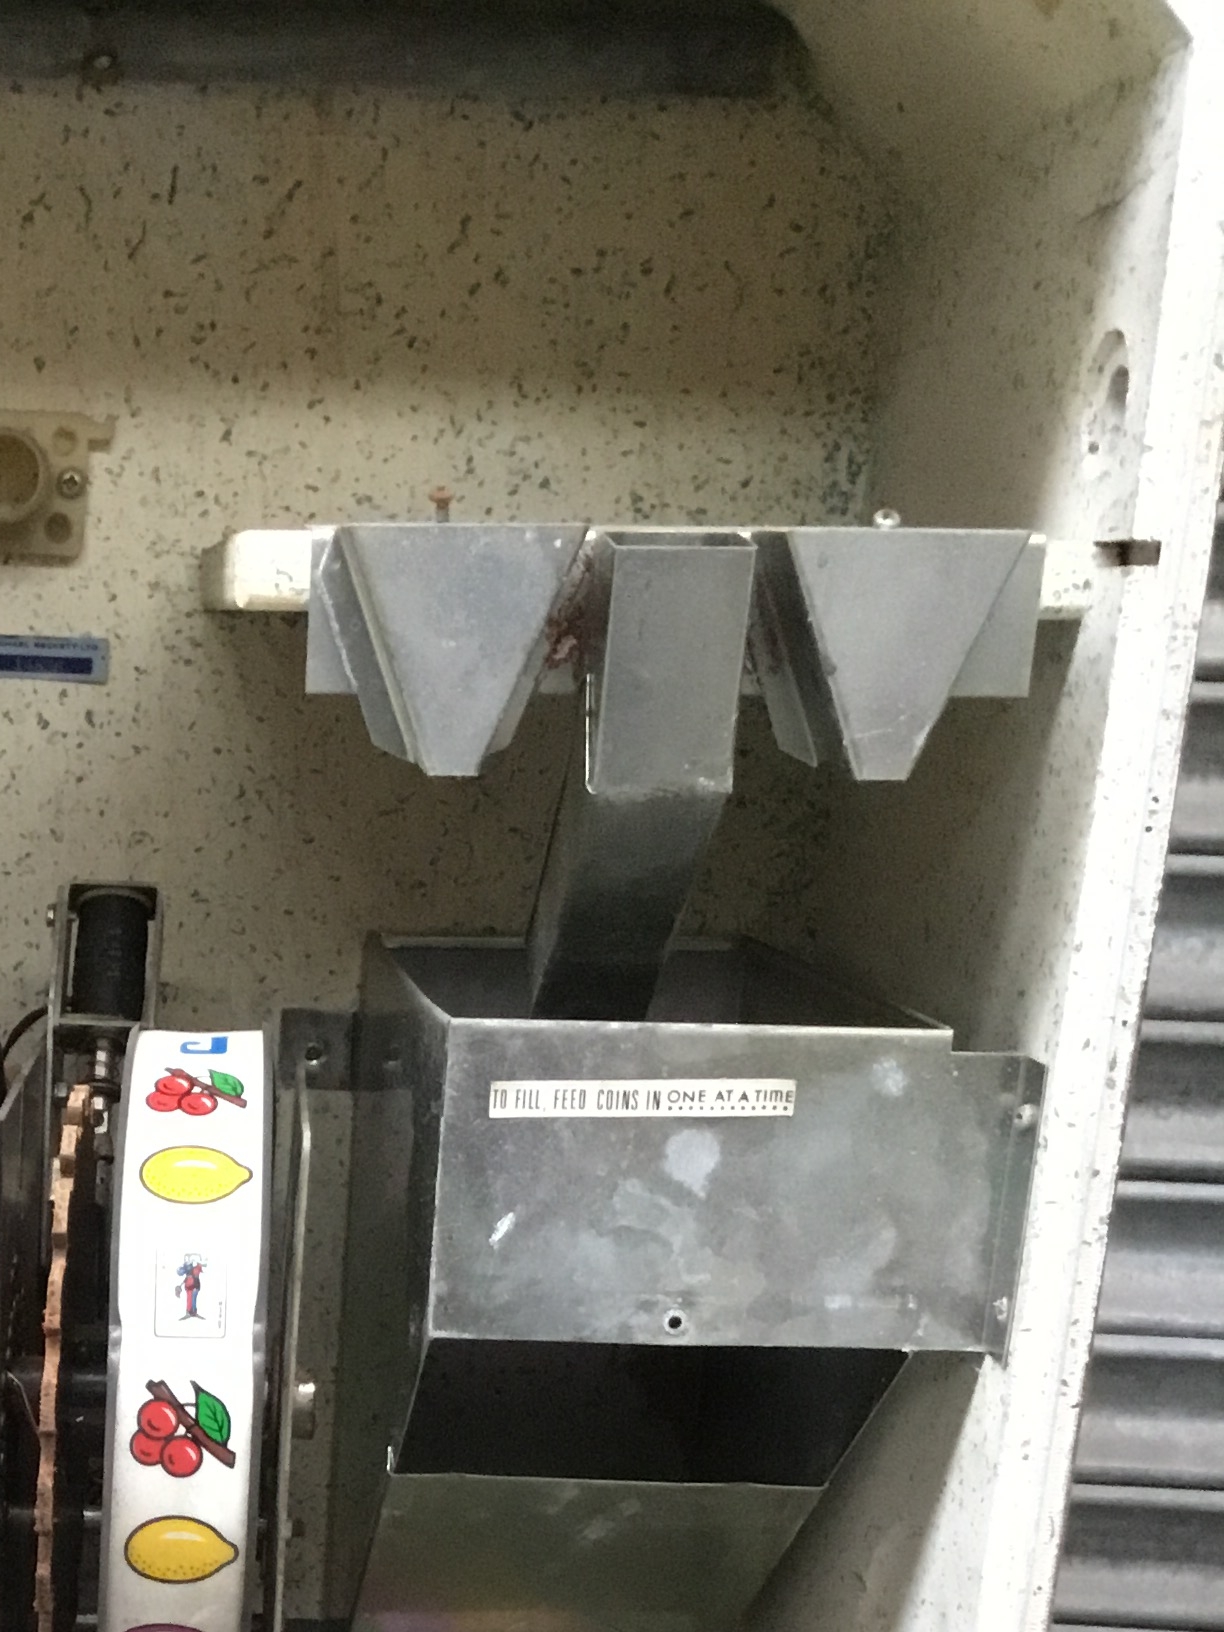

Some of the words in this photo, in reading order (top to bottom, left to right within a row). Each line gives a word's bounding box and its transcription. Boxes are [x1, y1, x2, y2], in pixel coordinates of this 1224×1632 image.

[493, 1089, 507, 1109] TO
[553, 1089, 587, 1110] FEED
[597, 1089, 640, 1111] COINS
[646, 1089, 661, 1111] IN
[667, 1089, 707, 1103] ONE
[715, 1089, 734, 1103] AT
[738, 1090, 750, 1103] A
